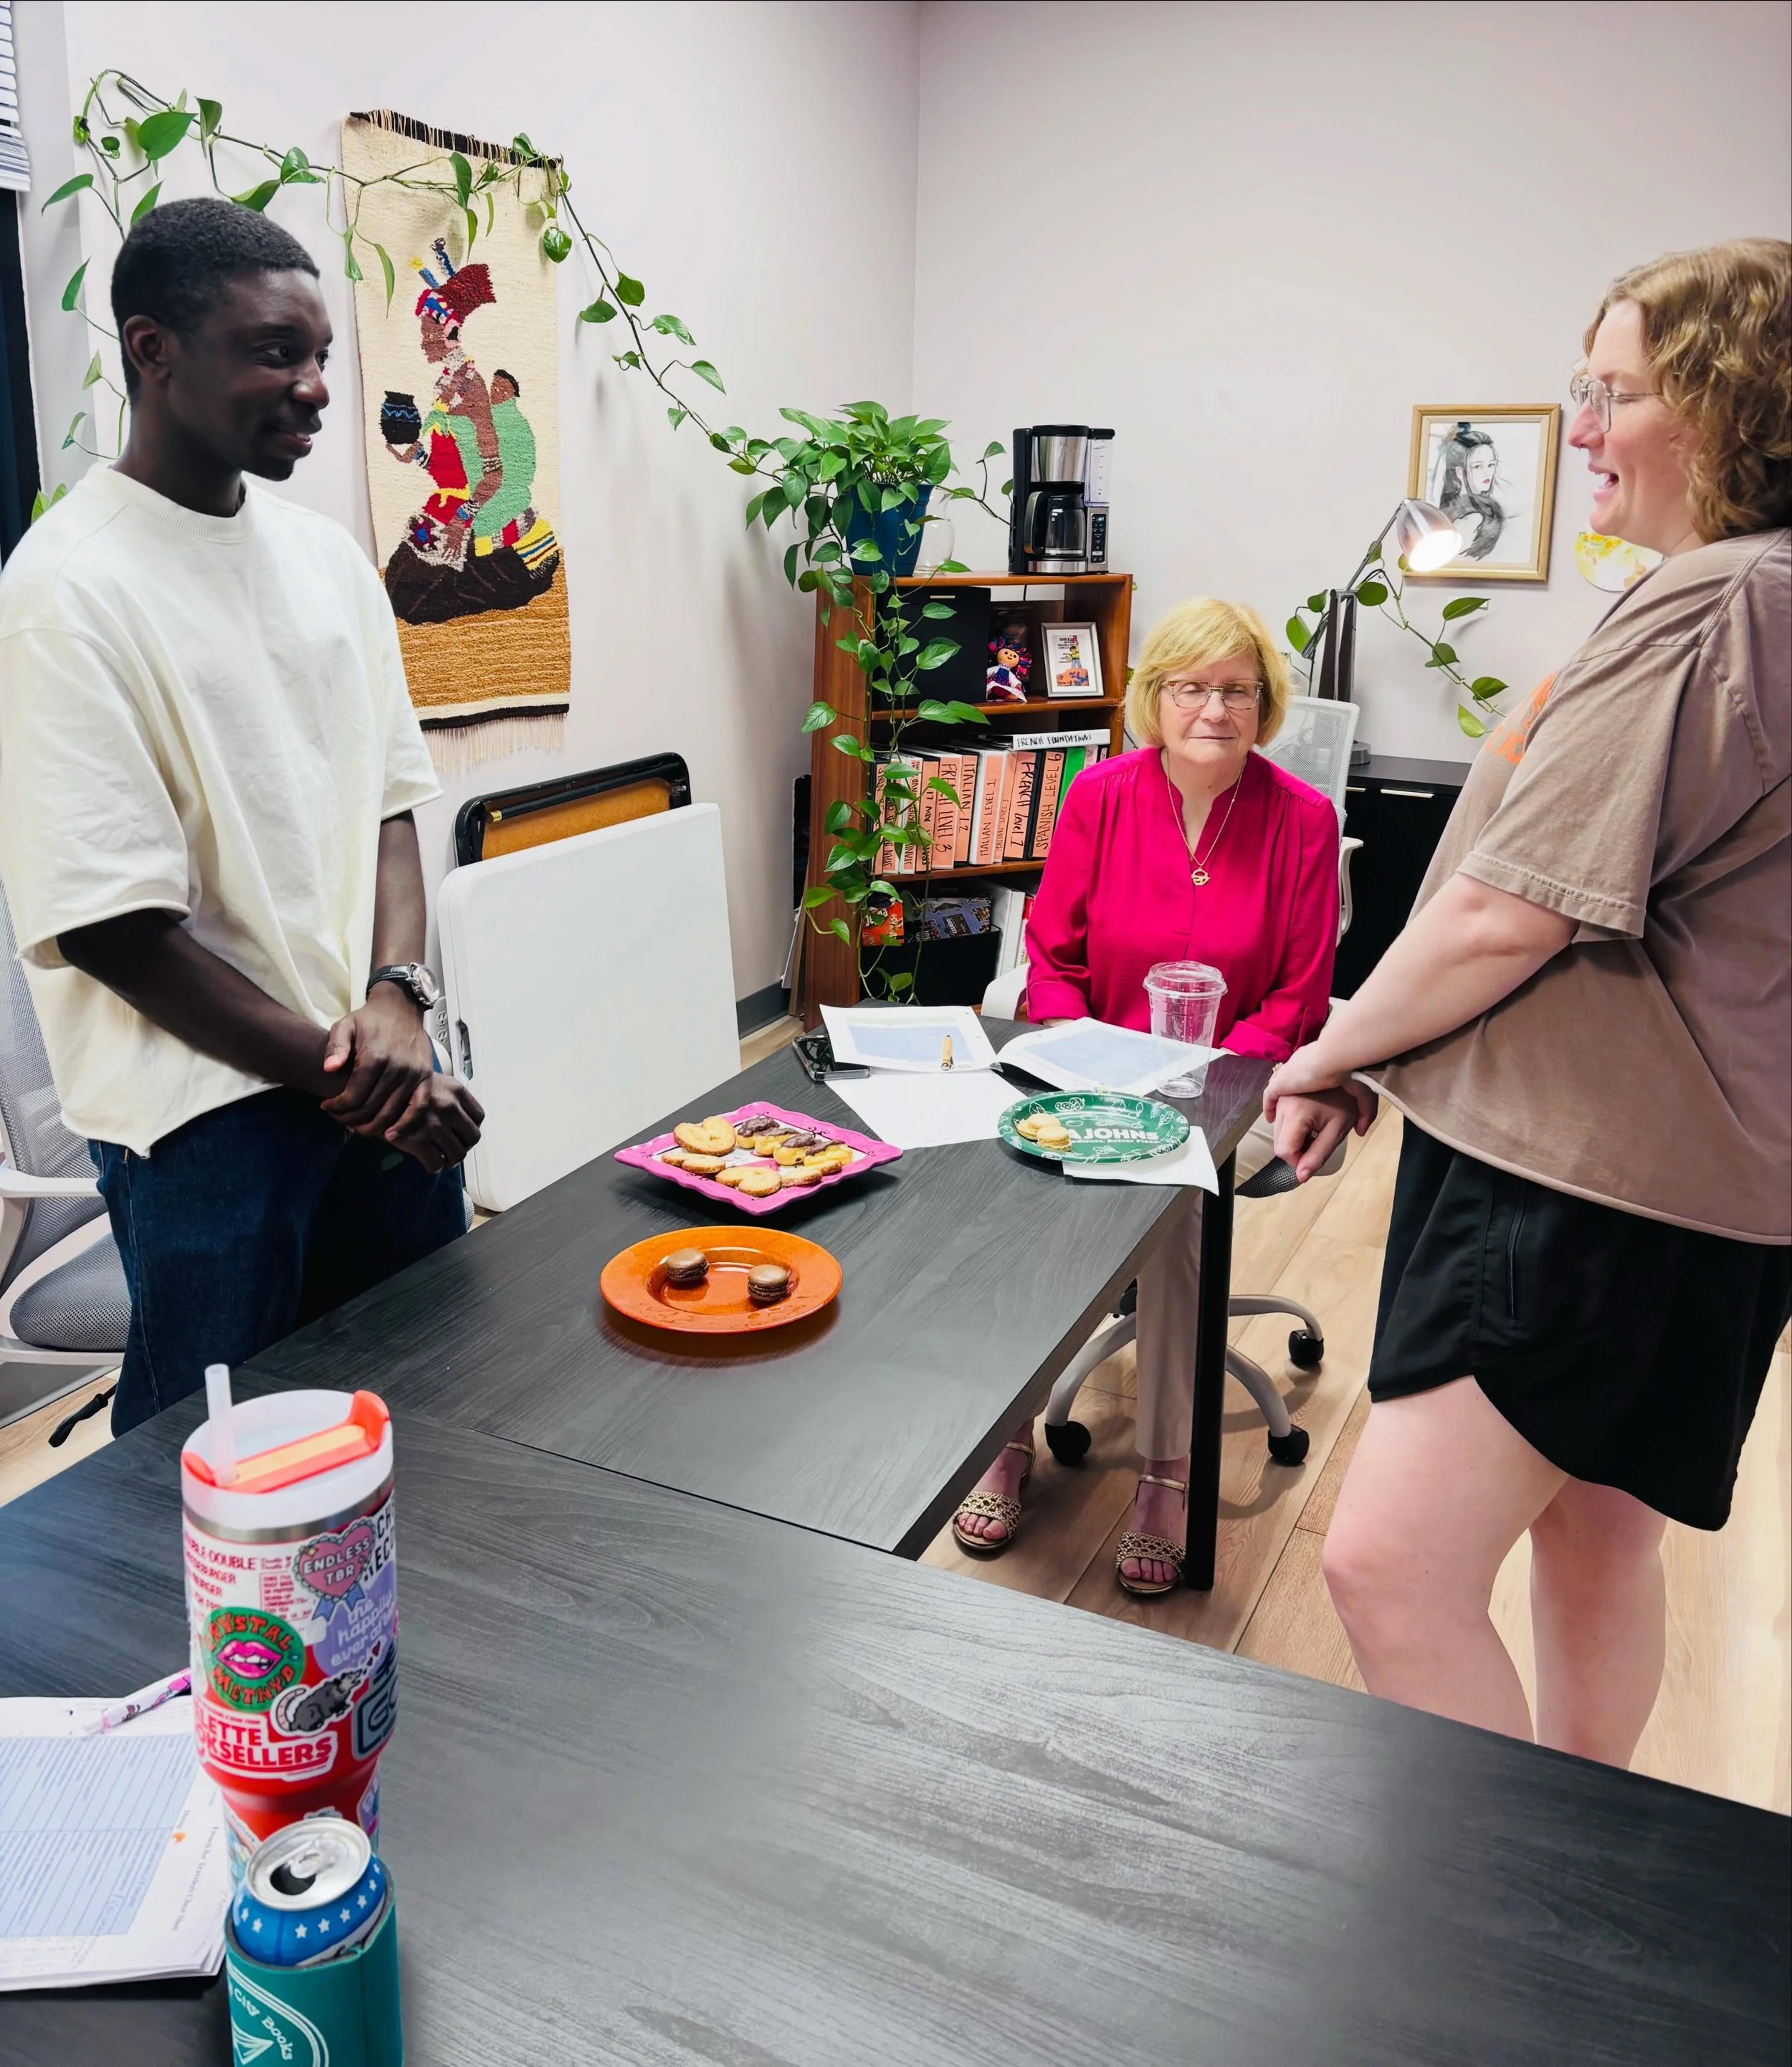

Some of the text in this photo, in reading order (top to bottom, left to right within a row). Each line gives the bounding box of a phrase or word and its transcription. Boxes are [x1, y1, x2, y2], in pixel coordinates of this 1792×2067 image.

[1017, 735, 1092, 747] FRENCH FOUNDATIONS
[958, 763, 975, 833] ITALIAN L2
[1017, 762, 1036, 807] FRENCH
[1044, 766, 1059, 797] LEVEL
[924, 806, 933, 822] ADV
[935, 763, 958, 853] FREH LEVEL 3
[980, 778, 996, 856] ITALIAN LEVEL 1
[1000, 805, 1009, 823] LEVEL
[1036, 805, 1054, 849] SPANISH
[303, 1537, 370, 1575] ENDLESS
[325, 1565, 355, 1586] TBR
[204, 1613, 293, 1651] CRYSTAL
[331, 1635, 368, 1667] ever
[211, 1665, 295, 1705] METHYD
[261, 2015, 293, 2061] Books
